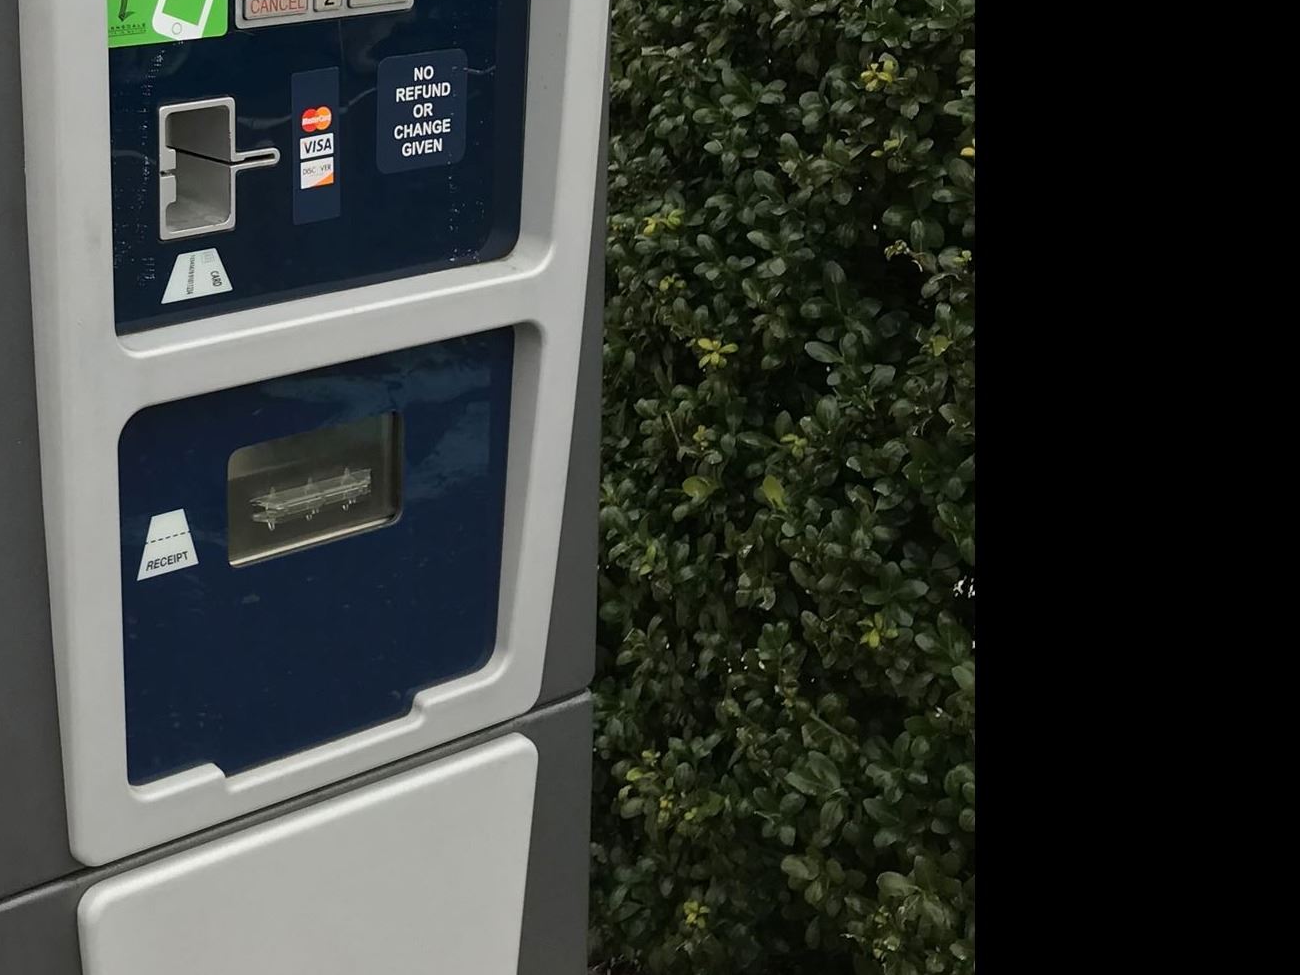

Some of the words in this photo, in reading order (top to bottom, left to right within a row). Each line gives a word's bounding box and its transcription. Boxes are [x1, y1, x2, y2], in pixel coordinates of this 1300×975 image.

[413, 65, 434, 81] NO
[396, 83, 451, 102] REFUND
[413, 102, 434, 118] OR
[394, 119, 451, 139] CHANGE
[304, 138, 331, 154] VISA
[402, 138, 443, 157] GIVEN
[303, 164, 331, 175] DISCVER
[210, 271, 223, 287] CARD
[145, 550, 189, 571] RECEIPT
